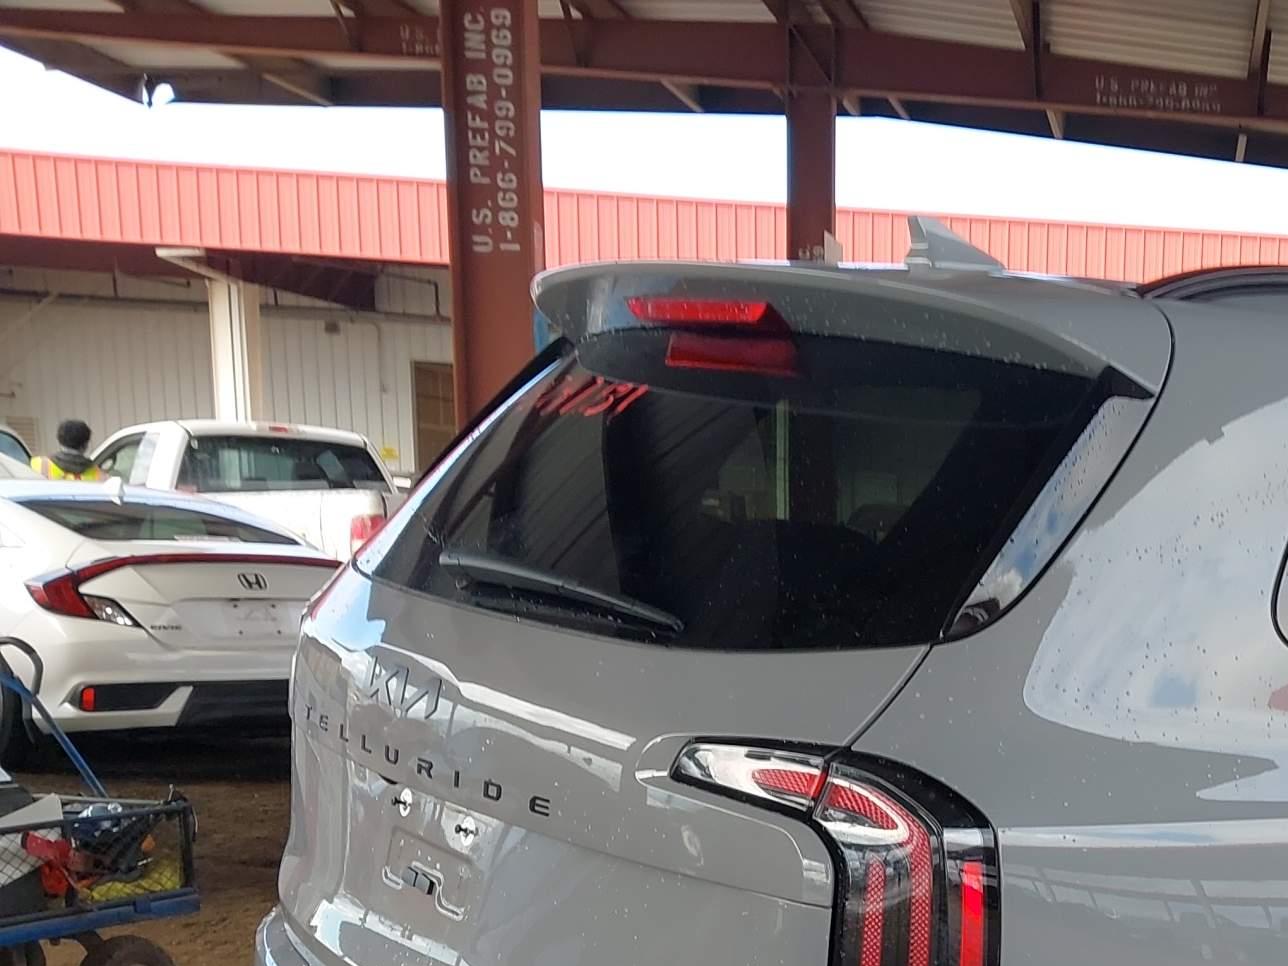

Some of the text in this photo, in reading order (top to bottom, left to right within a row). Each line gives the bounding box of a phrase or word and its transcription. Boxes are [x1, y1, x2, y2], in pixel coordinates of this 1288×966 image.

[466, 73, 491, 184] PREFAB
[490, 7, 521, 252] 1-866-799-0969
[472, 199, 493, 253] U.S.
[303, 703, 551, 817] TELLURIDE
